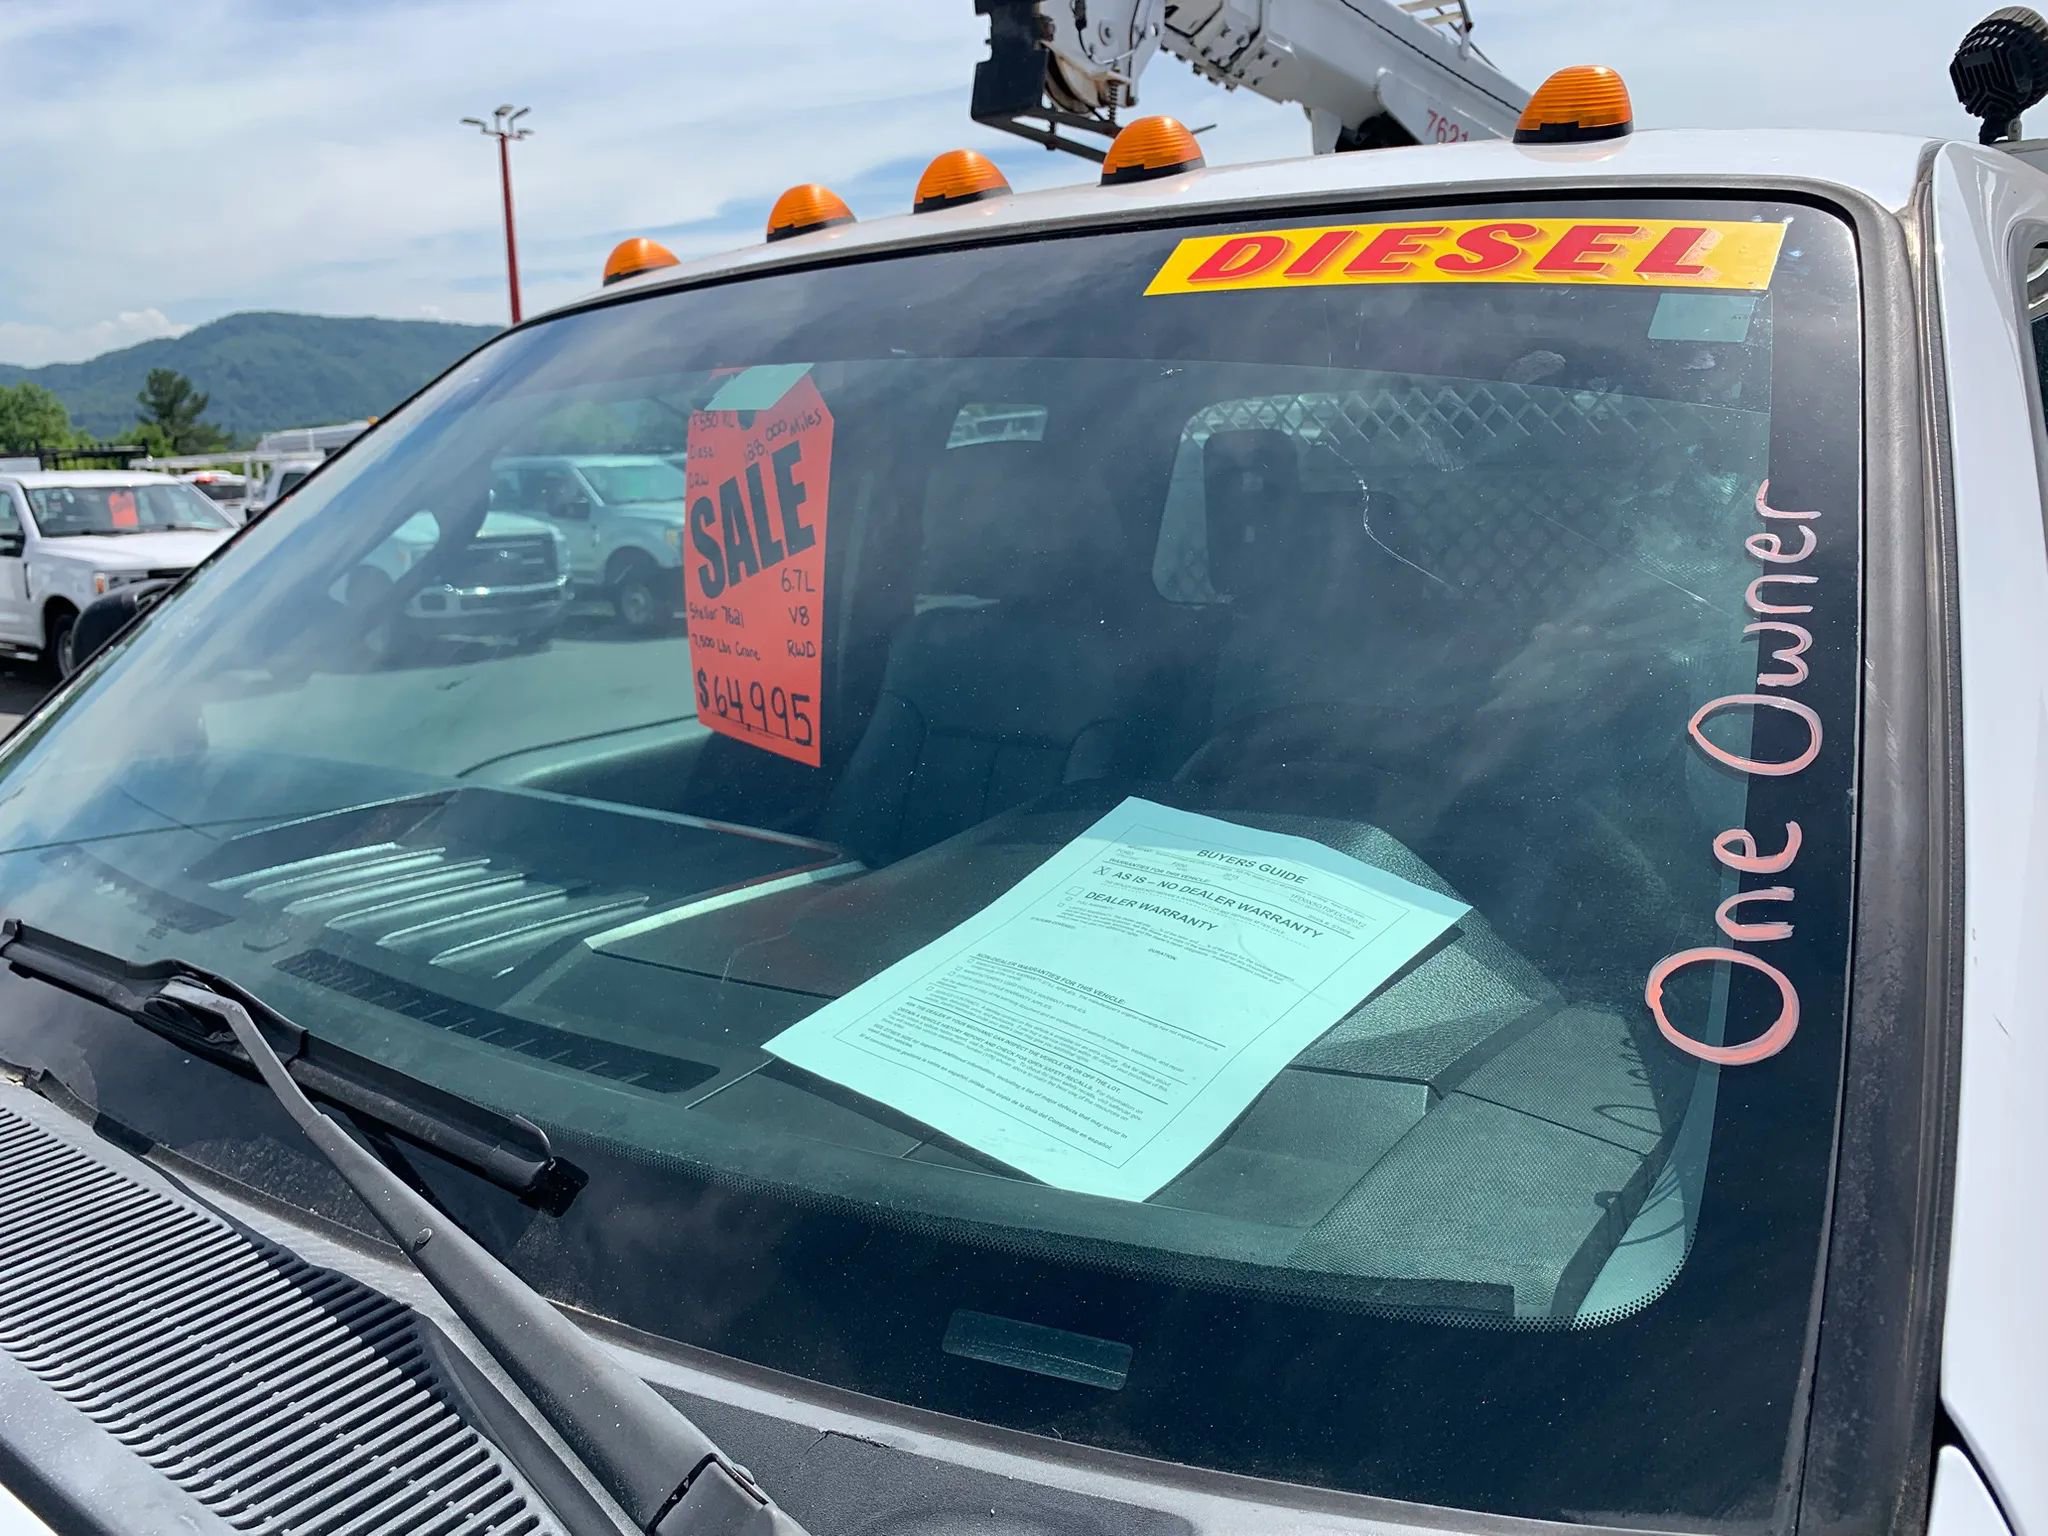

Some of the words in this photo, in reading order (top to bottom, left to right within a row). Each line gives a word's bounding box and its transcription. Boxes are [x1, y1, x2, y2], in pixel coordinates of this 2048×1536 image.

[1187, 222, 1719, 281] DIESEL
[691, 440, 816, 599] SALE
[780, 567, 816, 593] 6.7L
[788, 606, 811, 626] V8
[1688, 478, 1823, 777] Owner
[786, 640, 817, 659] RWD
[697, 667, 814, 747] $64,995
[1196, 849, 1257, 869] BUYERS
[1258, 863, 1309, 885] GUIDE
[1085, 891, 1138, 908] DEALER
[1138, 902, 1220, 932] WARRANTY
[1112, 871, 1133, 881] AS
[1132, 875, 1148, 884] IS
[1156, 880, 1179, 890] NO
[1178, 885, 1237, 908] DEALER
[1237, 902, 1324, 939] WARRANTY
[1645, 820, 1803, 1066] One
[1017, 963, 1062, 979] WARRANTIES
[1061, 977, 1078, 985] FOR
[1077, 983, 1093, 992] THIS
[1092, 989, 1125, 1004] VEHICLE:
[996, 1045, 1016, 1056] CHECK
[1016, 1053, 1028, 1061] FOR
[1044, 1066, 1066, 1078] SAFETY
[1005, 1039, 1029, 1052] INSPECT
[1040, 1054, 1063, 1066] VEHICLE
[1082, 1072, 1094, 1080] OFF
